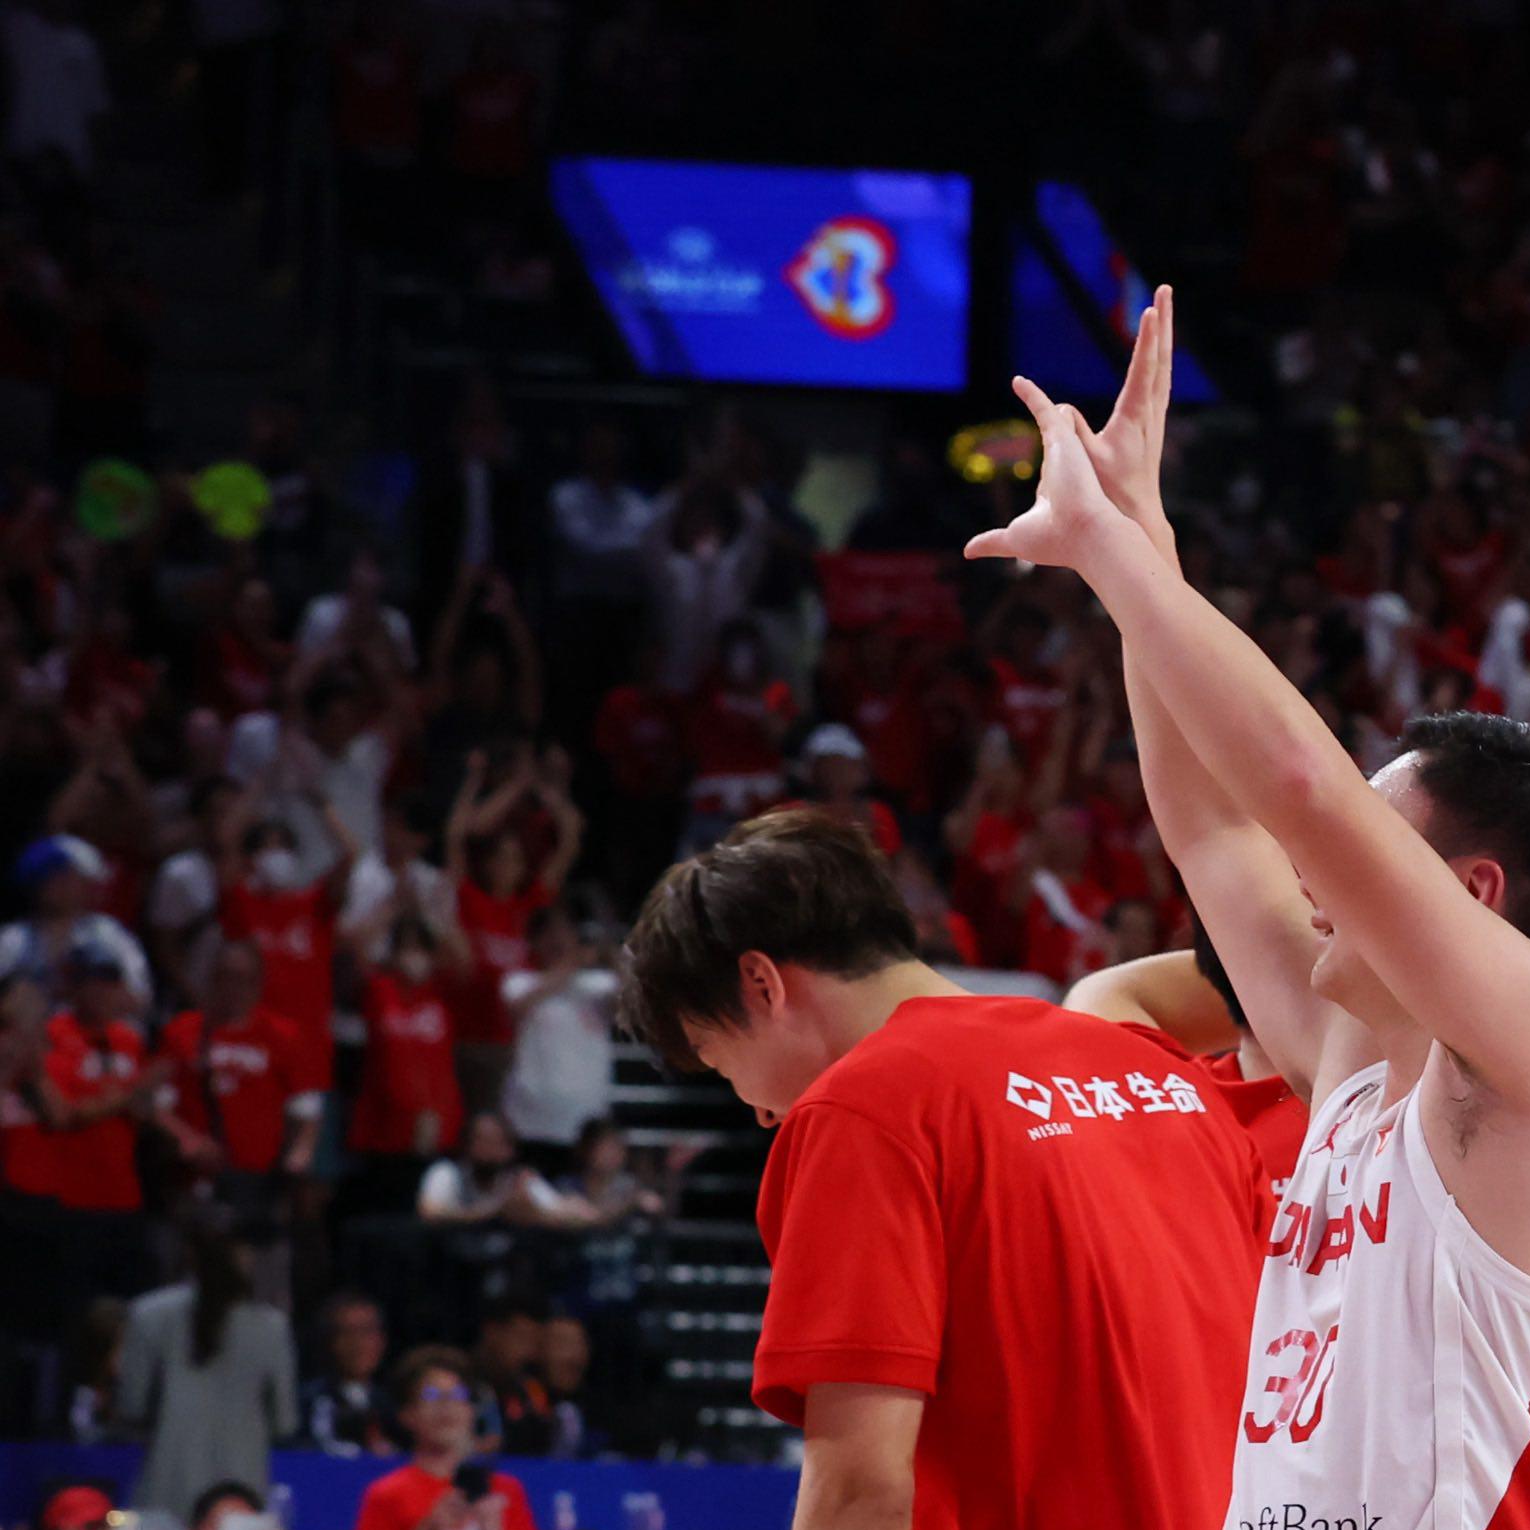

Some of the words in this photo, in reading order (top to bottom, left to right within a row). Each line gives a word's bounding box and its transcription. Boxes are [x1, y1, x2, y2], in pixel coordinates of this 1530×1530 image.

[1050, 1071, 1206, 1121] 日本生命
[1027, 1122, 1073, 1141] NISSAY
[1244, 1323, 1340, 1444] 30
